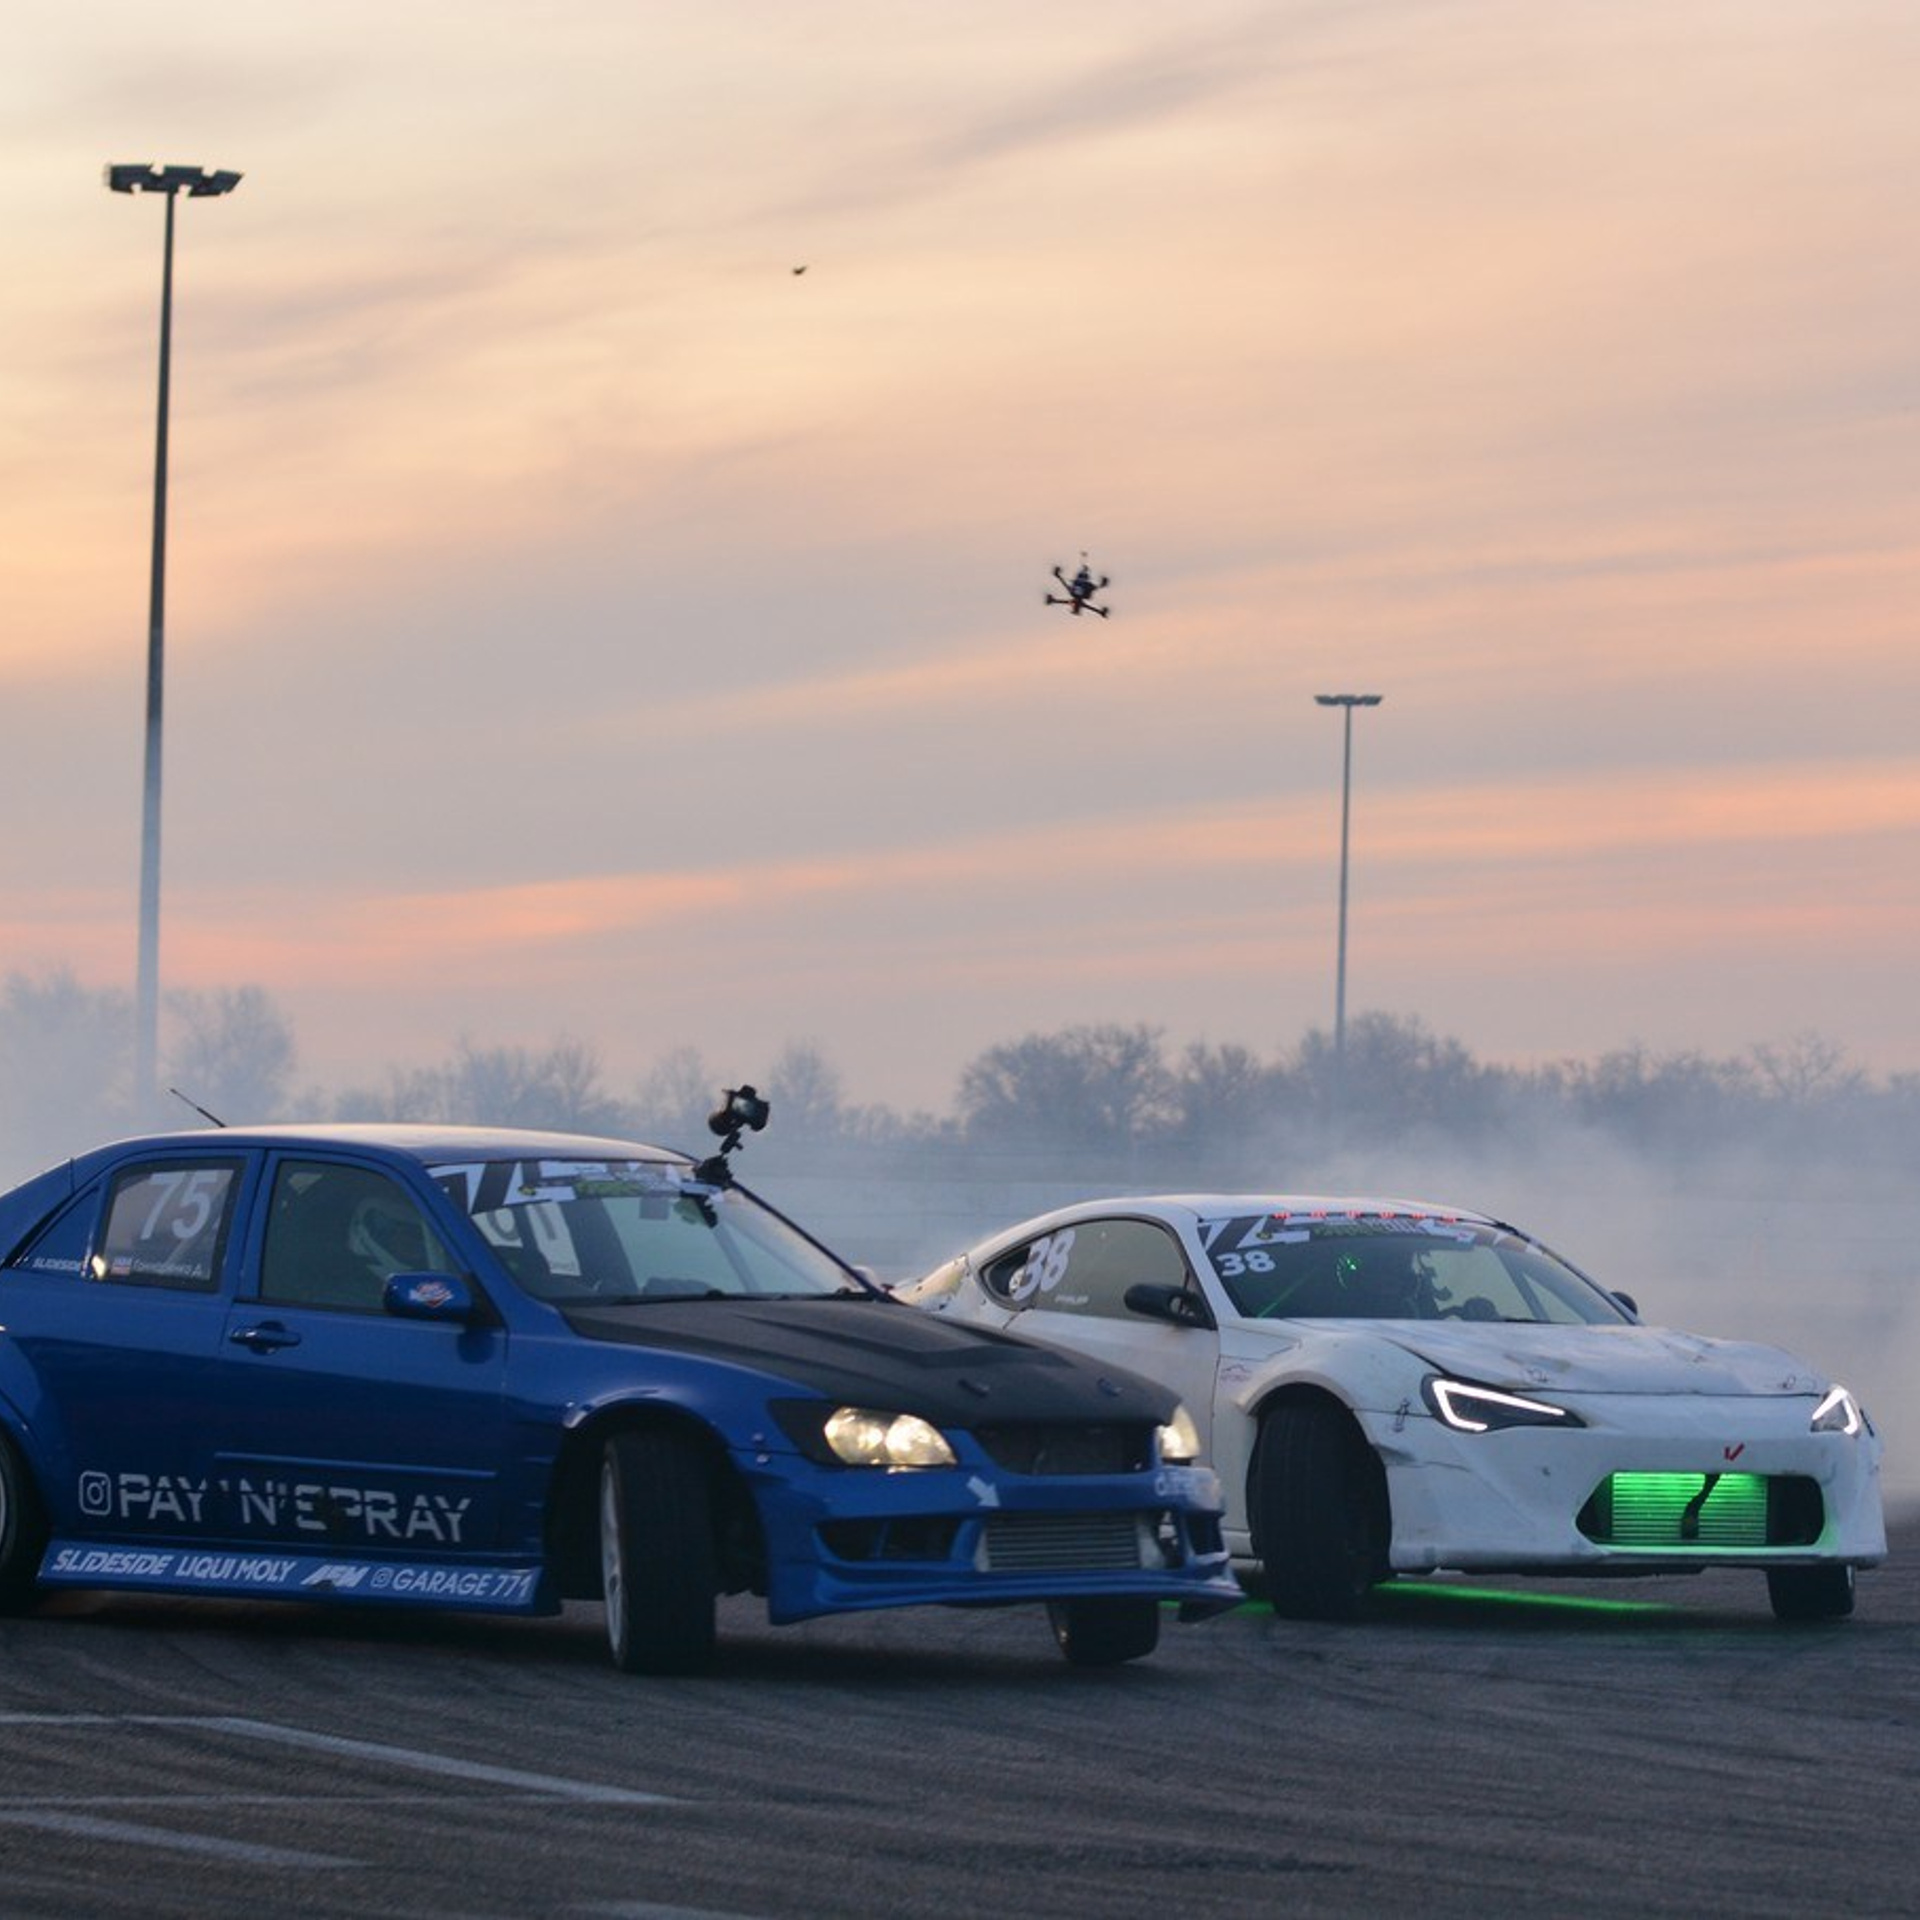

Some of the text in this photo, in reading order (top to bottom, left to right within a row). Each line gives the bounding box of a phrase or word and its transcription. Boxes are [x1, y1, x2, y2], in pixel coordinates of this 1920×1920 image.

[140, 1169, 217, 1241] 75
[1010, 1229, 1076, 1302] 38
[1216, 1250, 1277, 1277] 38
[52, 1549, 297, 1583] SLIDESIDE LIQUI MOLY
[392, 1568, 533, 1598] GARAGE 771
